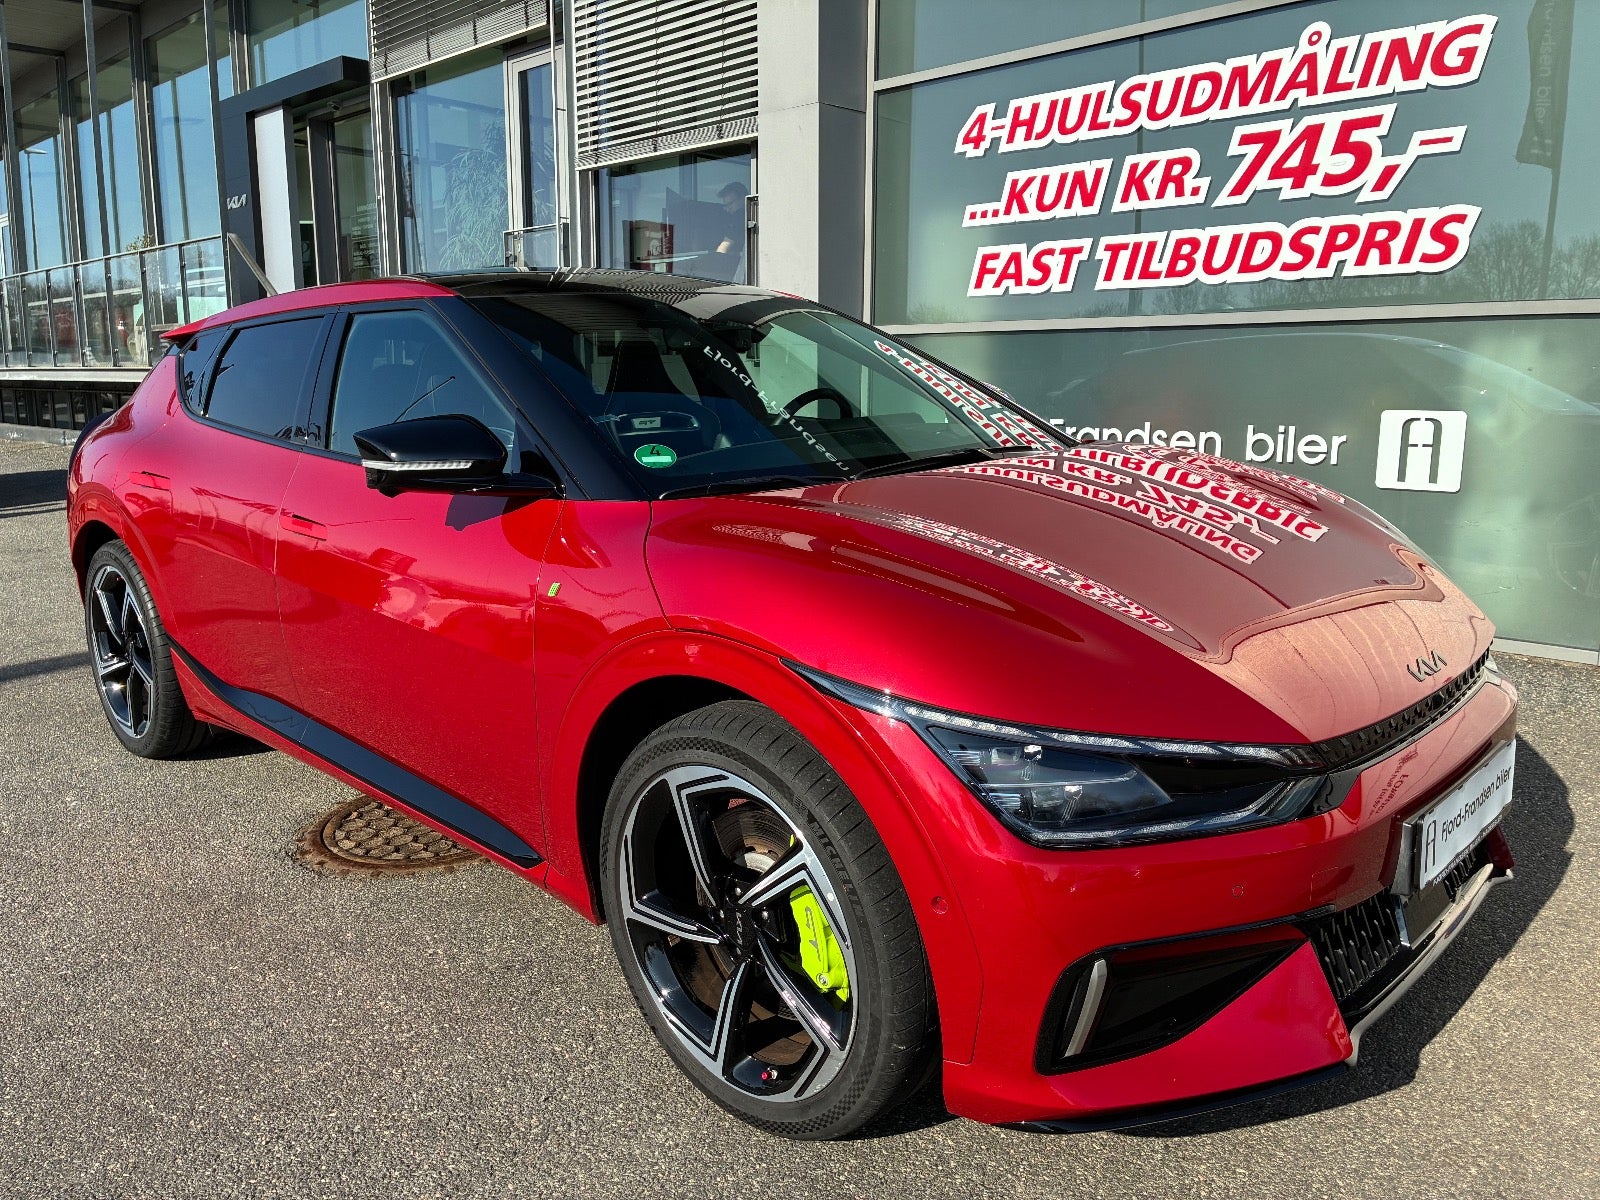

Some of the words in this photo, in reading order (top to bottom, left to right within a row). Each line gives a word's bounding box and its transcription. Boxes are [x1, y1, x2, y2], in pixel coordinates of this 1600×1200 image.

[959, 21, 1487, 152] 4-HJULSUDMÅLING
[966, 164, 1107, 223] ...KUN
[1117, 153, 1204, 206] KR.
[1224, 111, 1457, 200] 745,-
[971, 242, 1087, 292] FAST
[1100, 210, 1471, 284] TILBUDSPRIS
[648, 445, 662, 457] 4
[1245, 424, 1348, 465] biler
[1495, 765, 1512, 790] biler
